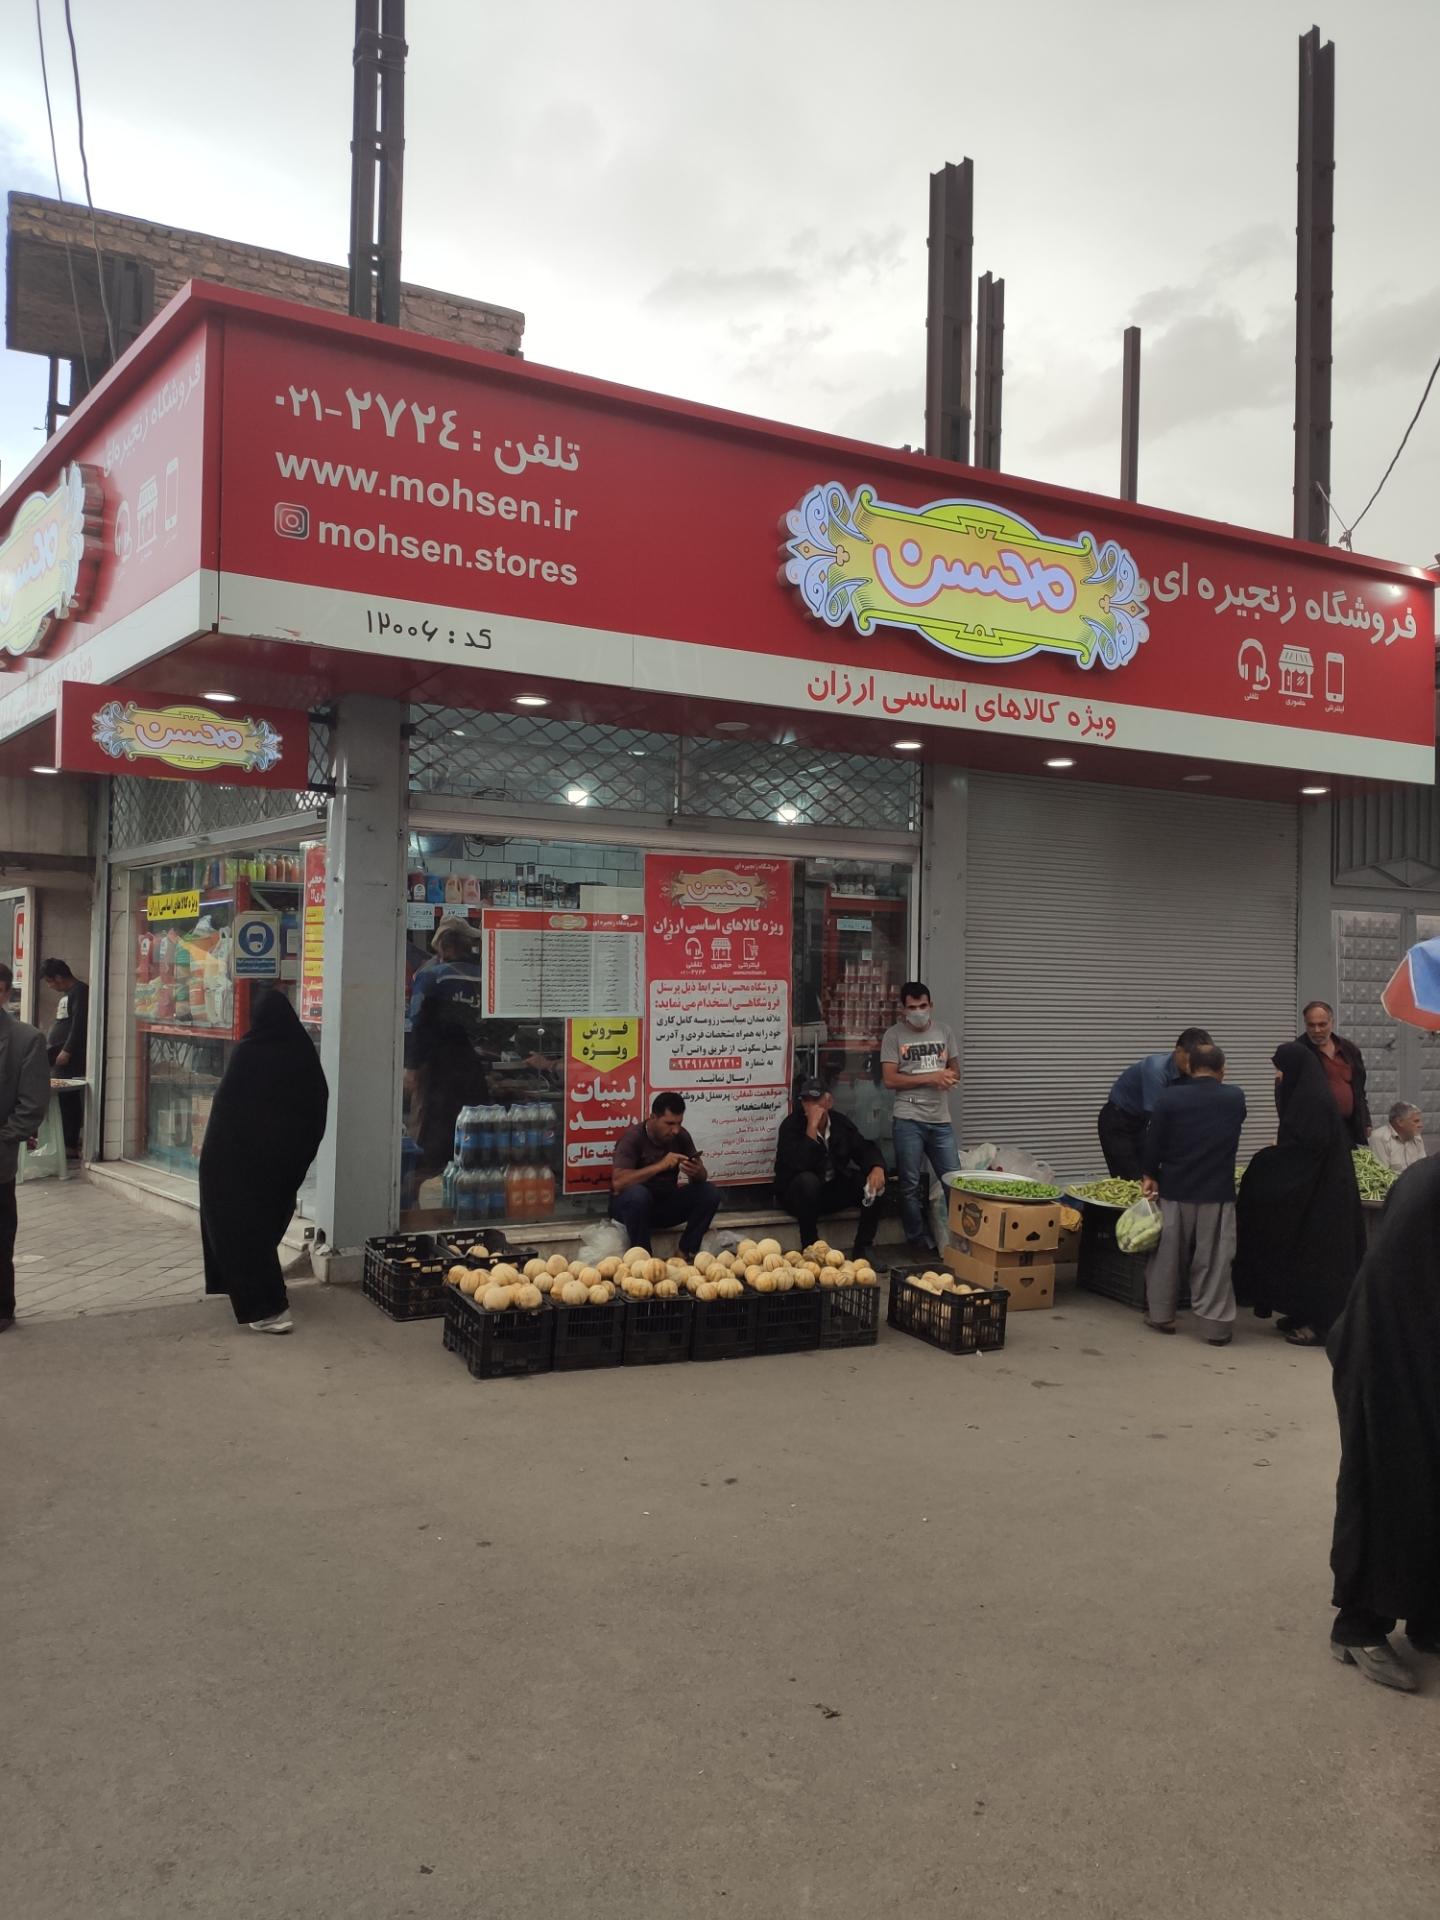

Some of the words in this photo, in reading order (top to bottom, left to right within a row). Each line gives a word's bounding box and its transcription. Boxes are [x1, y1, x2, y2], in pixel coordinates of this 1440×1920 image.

[275, 451, 579, 532] www.mohsen.ir
[318, 520, 579, 586] mohsen.stores
[872, 537, 1077, 613] محسن
[1153, 561, 1190, 603] ای
[1197, 577, 1298, 625] زنجیره
[1305, 590, 1418, 646] فروشگاه
[464, 628, 493, 650] کد
[806, 669, 875, 705] ارزان
[882, 683, 968, 715] اساسی
[974, 691, 1061, 724] کالاهای
[1067, 704, 1118, 740] ویژه
[134, 720, 244, 750] محسن
[687, 879, 752, 901] محسن
[652, 916, 684, 935] ارزان
[684, 917, 721, 935] اساسی
[721, 918, 762, 935] کالاهای
[762, 919, 784, 936] ویژه
[685, 961, 703, 970] تلفنی
[710, 961, 733, 970] حضوری
[656, 982, 681, 995] پرسنل
[681, 981, 696, 994] ذیل
[698, 982, 721, 994] شرایط
[727, 983, 750, 994] محسن
[750, 982, 778, 994] فروشگاه
[681, 1001, 696, 1011] می
[696, 998, 732, 1011] استخدام
[732, 998, 780, 1011] فروشگاهی
[656, 1015, 676, 1026] کاری
[676, 1015, 693, 1026] کامل
[582, 1021, 629, 1040] فروش
[655, 1029, 679, 1041] آدرس
[685, 1031, 705, 1041] فردی
[705, 1030, 735, 1039] مشخصات
[735, 1031, 755, 1040] همراه
[768, 1030, 782, 1038] خود
[582, 1043, 628, 1060] ویژه
[707, 1044, 728, 1055] طریق
[729, 1044, 735, 1055] از
[737, 1044, 760, 1055] سکونت
[761, 1043, 782, 1054] محل
[902, 1043, 946, 1061] URBAN
[745, 1057, 765, 1068] شماره
[766, 1058, 774, 1066] به
[920, 1054, 939, 1069] ART
[725, 1073, 752, 1084] ارسال
[570, 1075, 637, 1108] لبنیات
[706, 1091, 731, 1102] پرسنل
[754, 1089, 782, 1098] موقعیت
[568, 1145, 595, 1164] عالی
